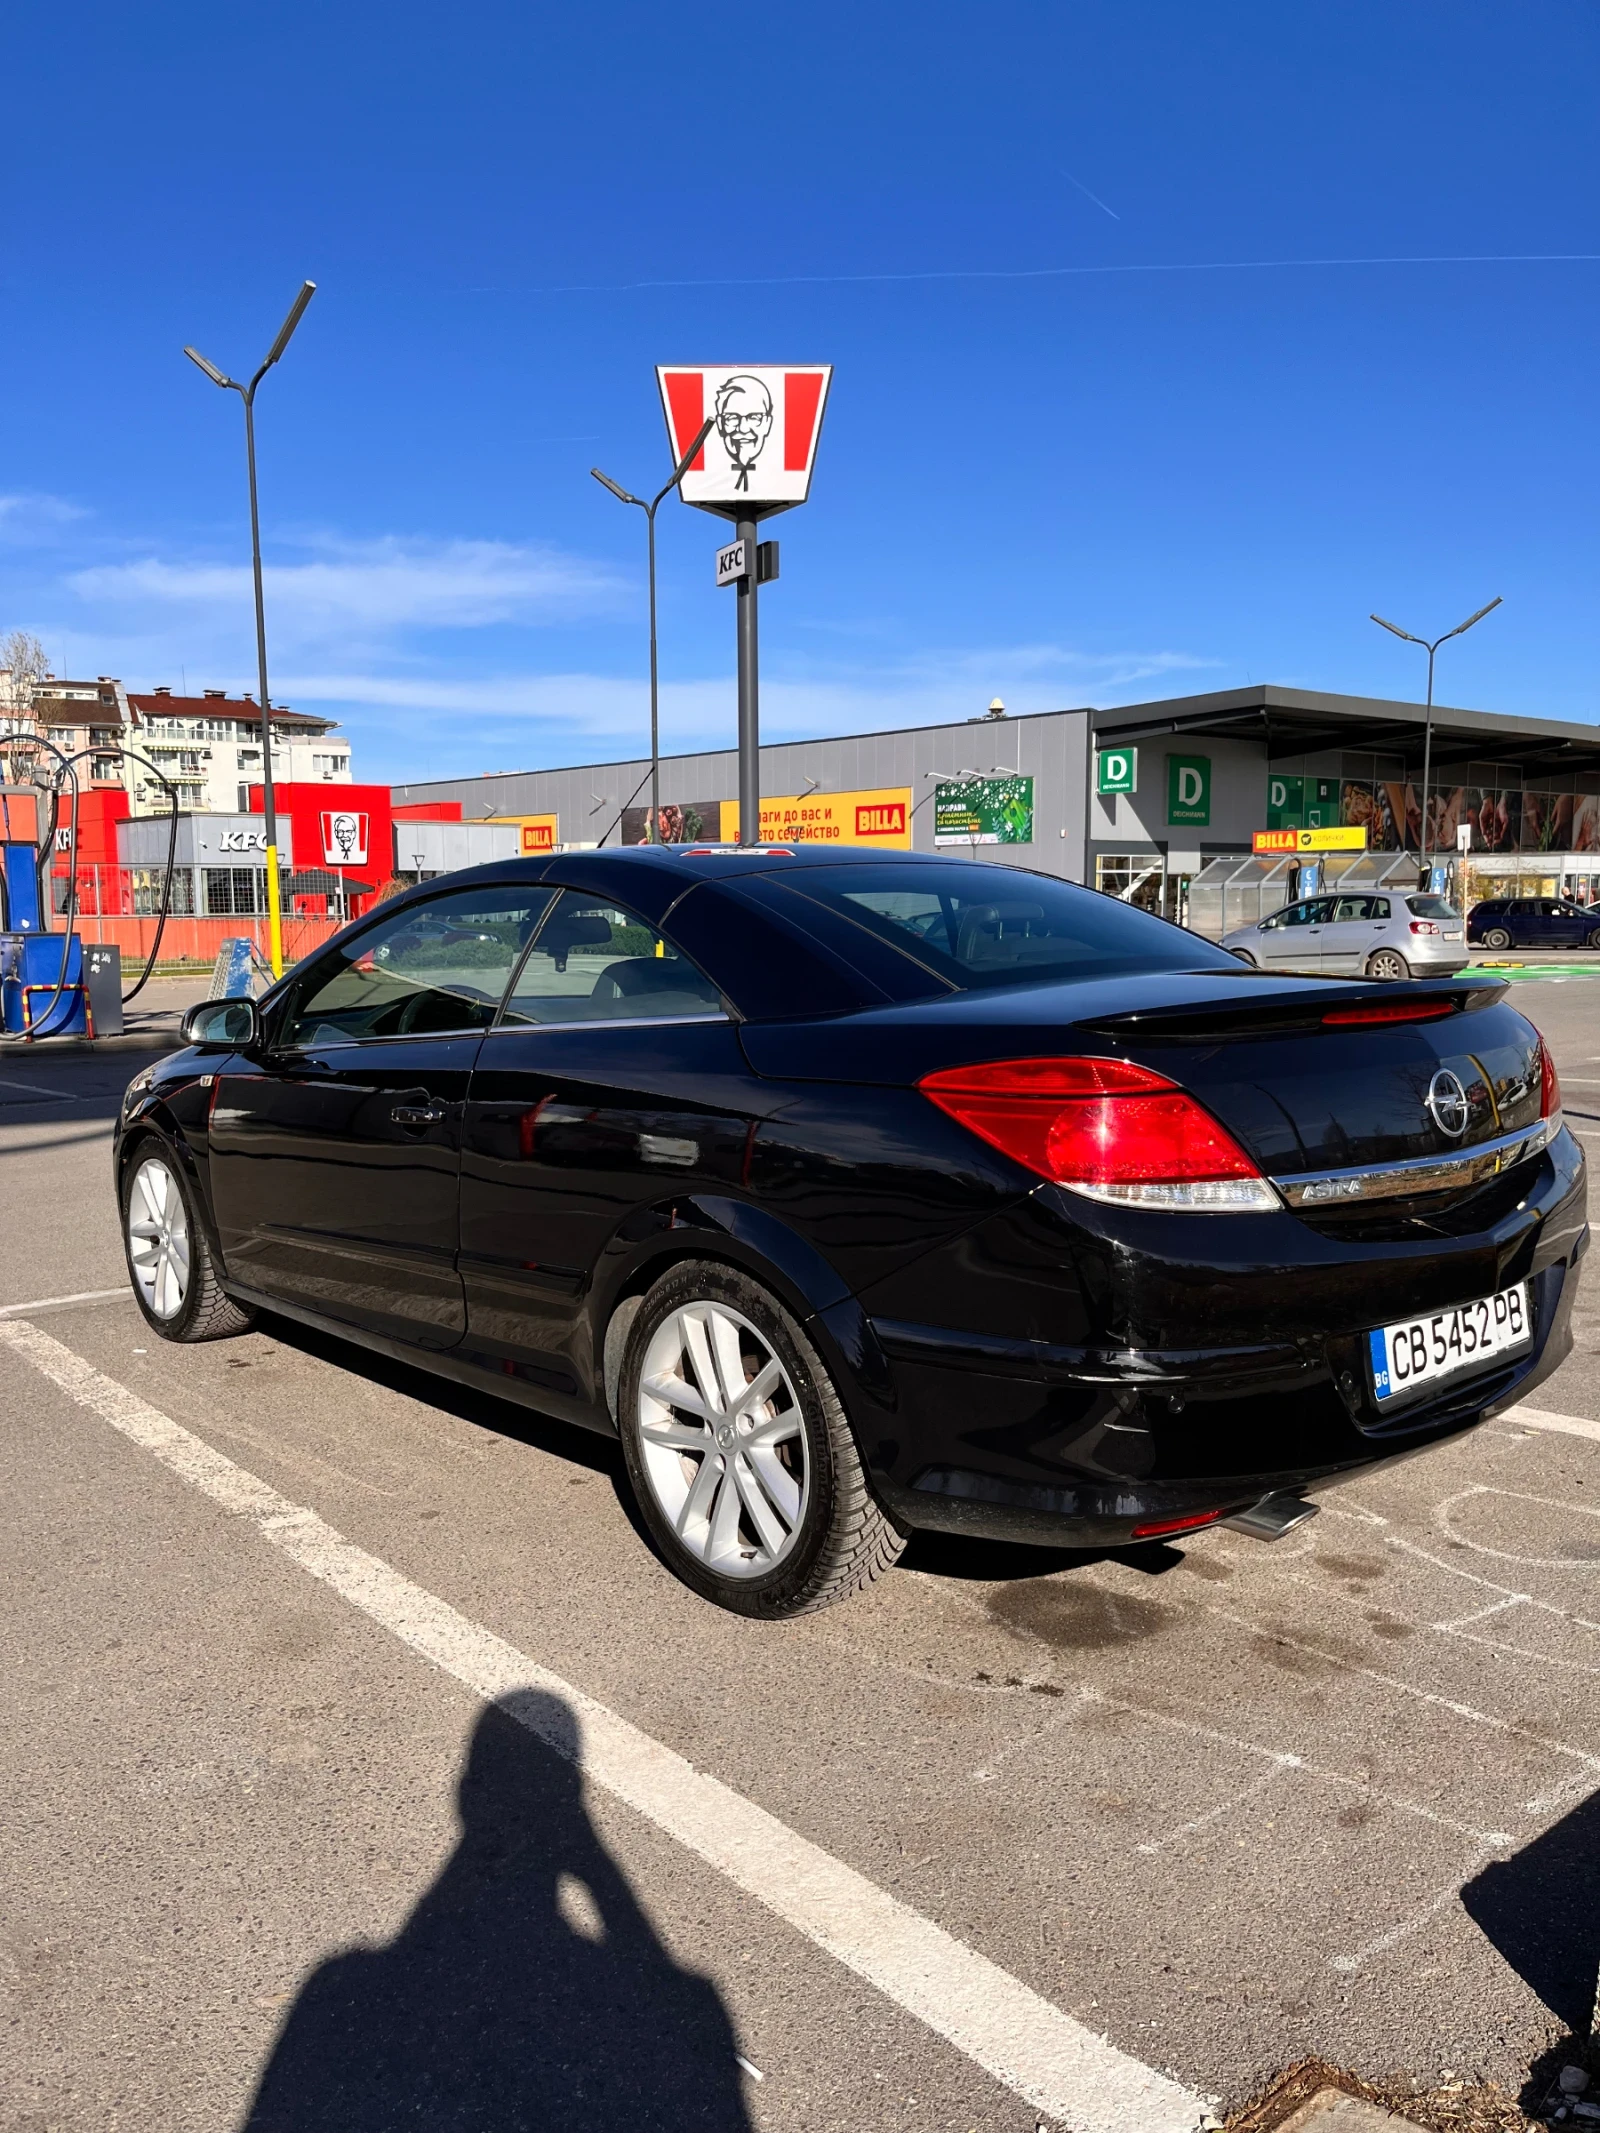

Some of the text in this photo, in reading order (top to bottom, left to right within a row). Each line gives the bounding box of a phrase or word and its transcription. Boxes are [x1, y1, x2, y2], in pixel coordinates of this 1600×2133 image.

[719, 547, 743, 575] KFC
[1107, 755, 1128, 781] D
[1178, 767, 1203, 806] D
[1271, 781, 1286, 807] D
[784, 810, 798, 825] до
[801, 809, 821, 821] вас
[825, 808, 832, 820] и
[858, 809, 903, 832] BILLA
[1172, 810, 1206, 818] DEICHMANN
[525, 829, 551, 847] BILLA
[777, 823, 840, 841] семейство
[1256, 833, 1295, 850] BILLA
[1302, 1180, 1362, 1200] ASTRA
[1392, 1325, 1427, 1380] CB
[1431, 1300, 1492, 1365] 5452
[1374, 1373, 1388, 1388] BG
